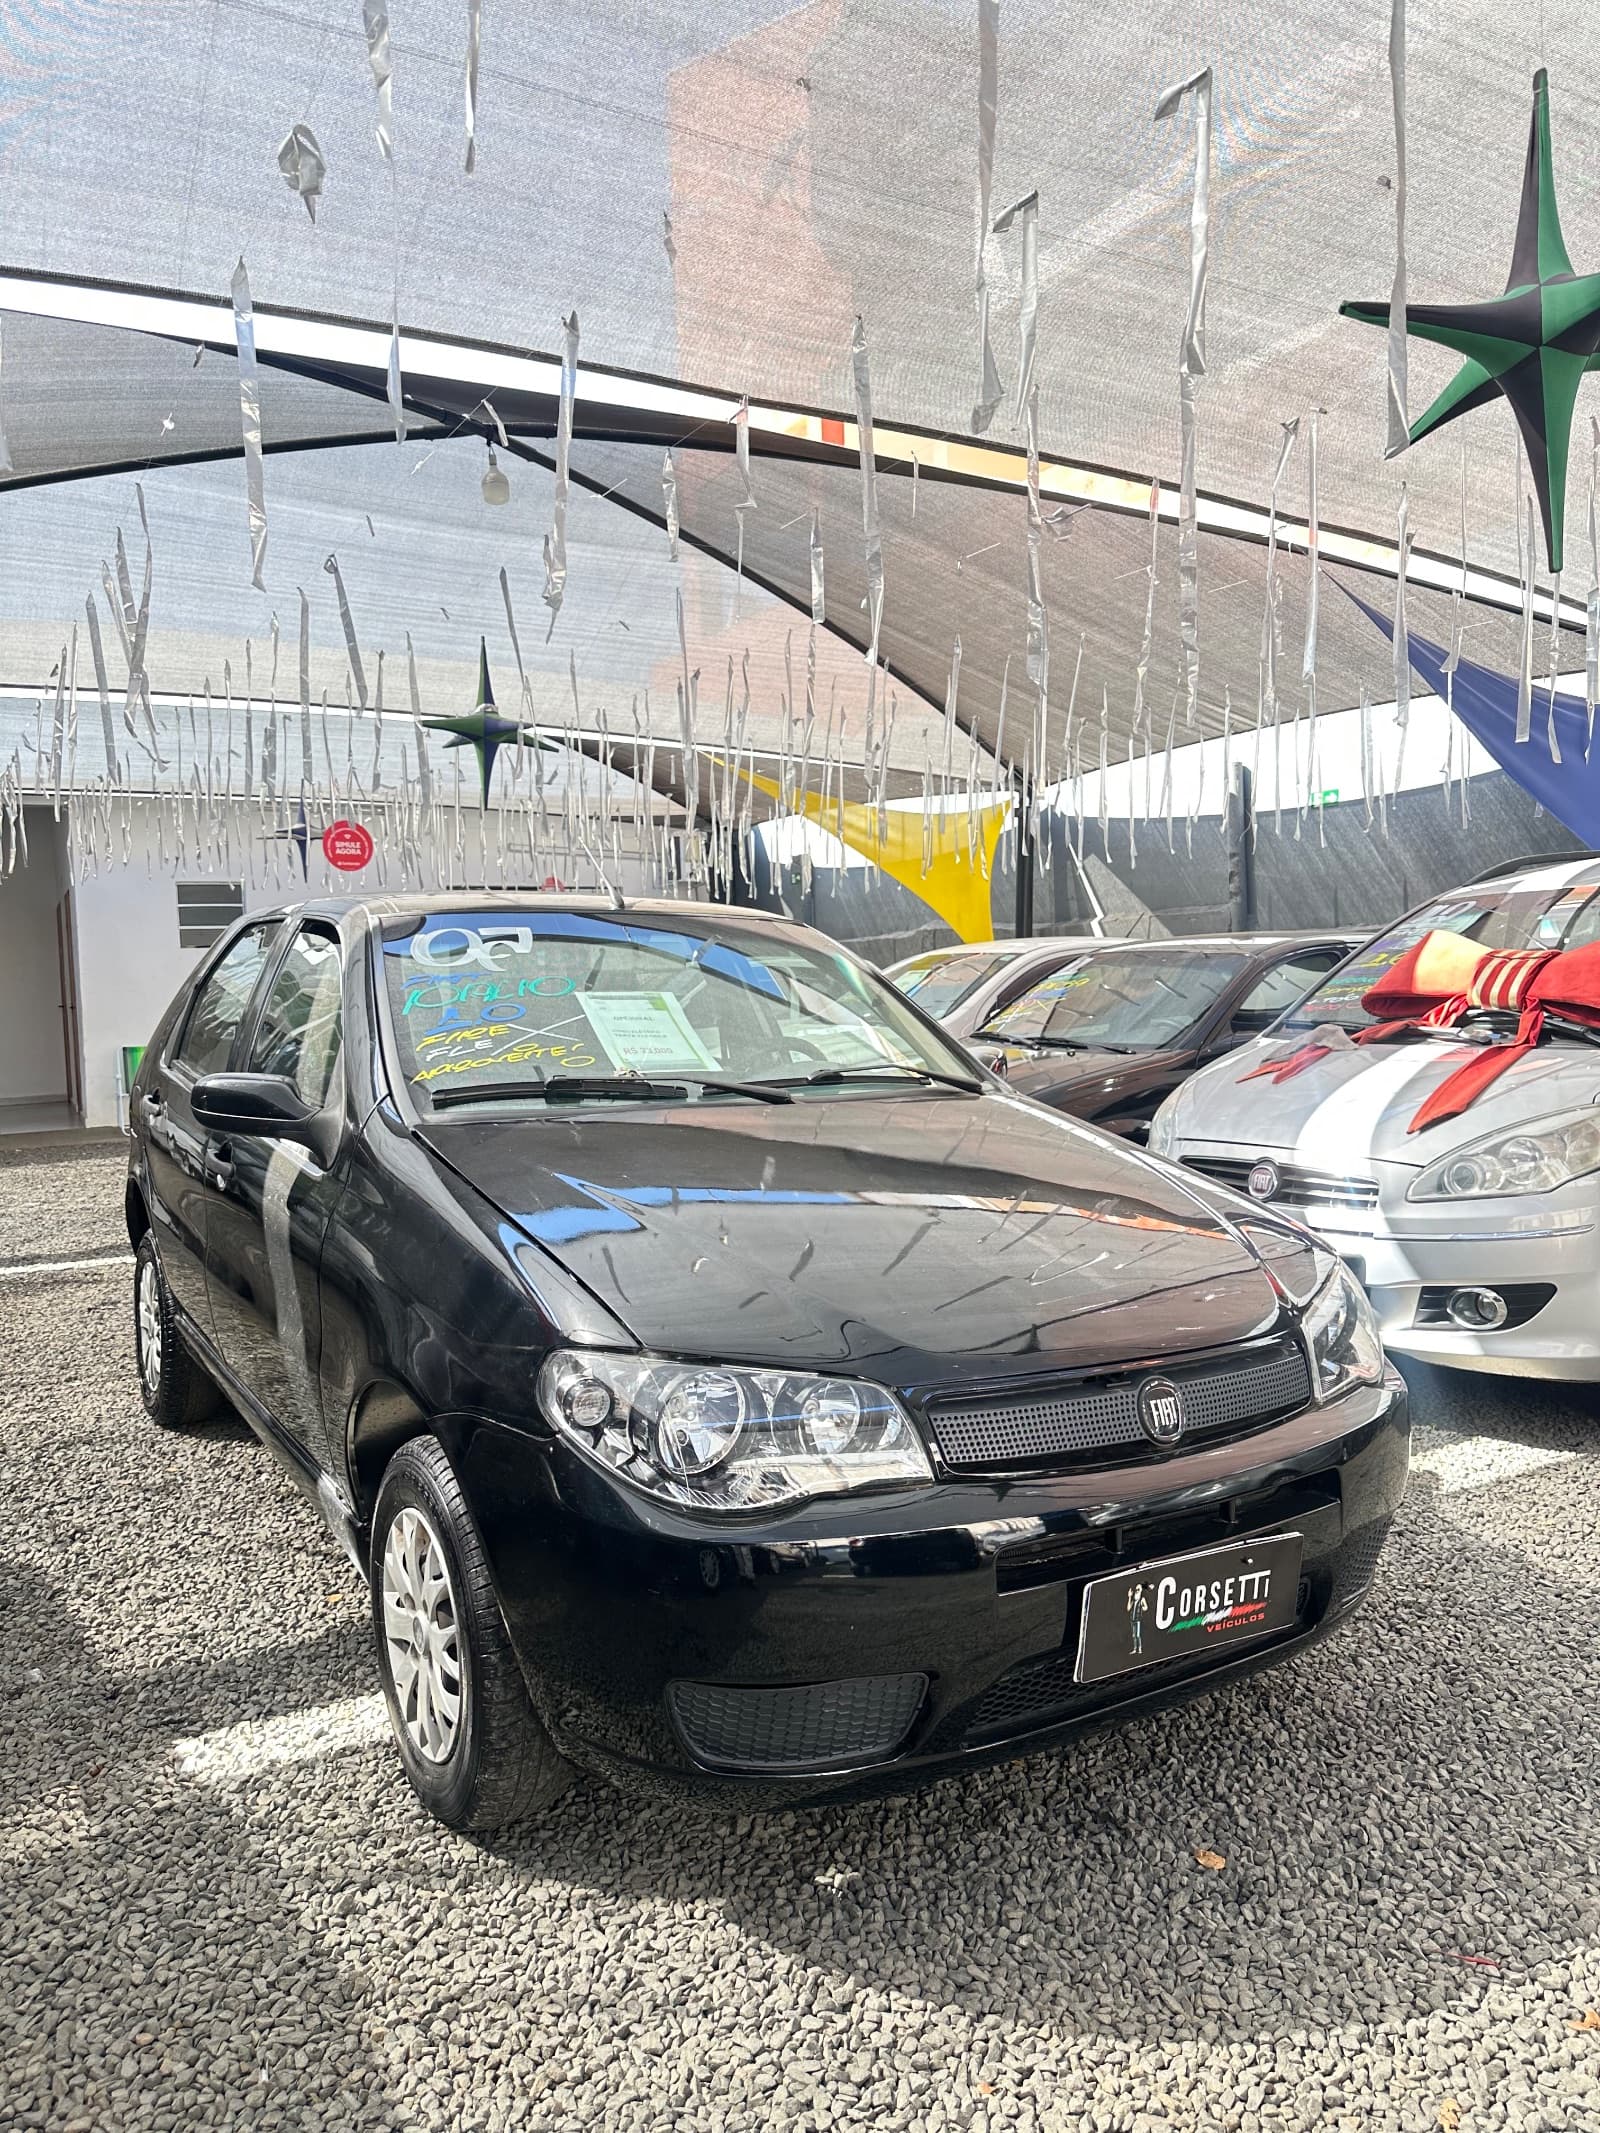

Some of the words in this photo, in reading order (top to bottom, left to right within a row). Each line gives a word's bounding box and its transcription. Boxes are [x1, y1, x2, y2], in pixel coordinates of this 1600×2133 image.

[402, 975, 577, 1015] PALIO
[424, 1002, 527, 1036] 1.0
[416, 1024, 510, 1051] FIRE
[1253, 1173, 1271, 1190] FIAT
[1149, 1396, 1178, 1428] FIAT
[1155, 1569, 1272, 1630] CORSETTI
[1206, 1612, 1265, 1633] VEÍCULOS
